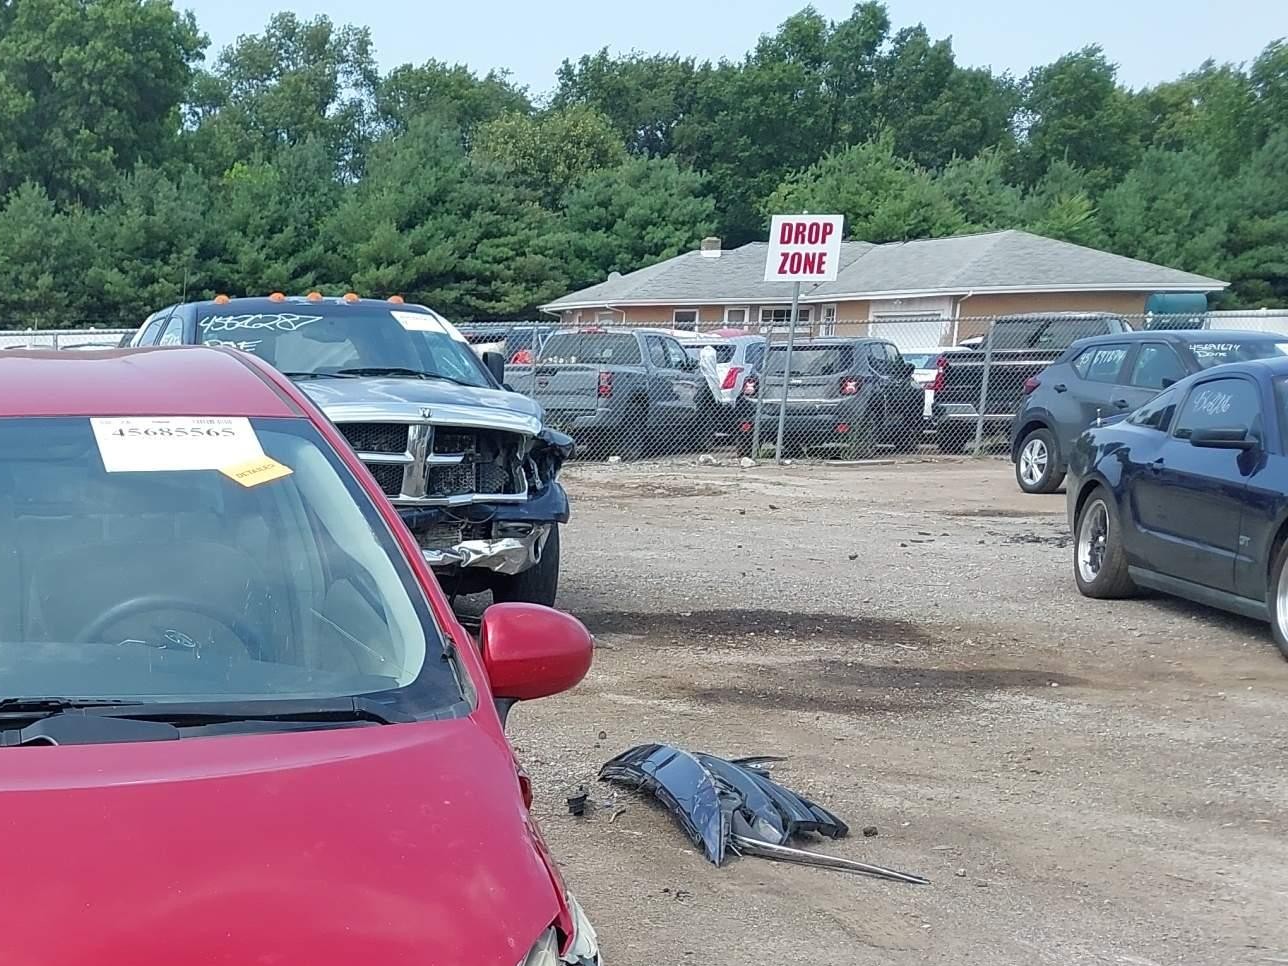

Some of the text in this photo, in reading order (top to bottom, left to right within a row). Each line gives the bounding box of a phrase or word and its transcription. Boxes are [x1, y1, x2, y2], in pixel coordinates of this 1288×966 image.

[780, 222, 833, 245] DROP
[778, 252, 827, 274] ZONE
[111, 427, 237, 438] 45685565
